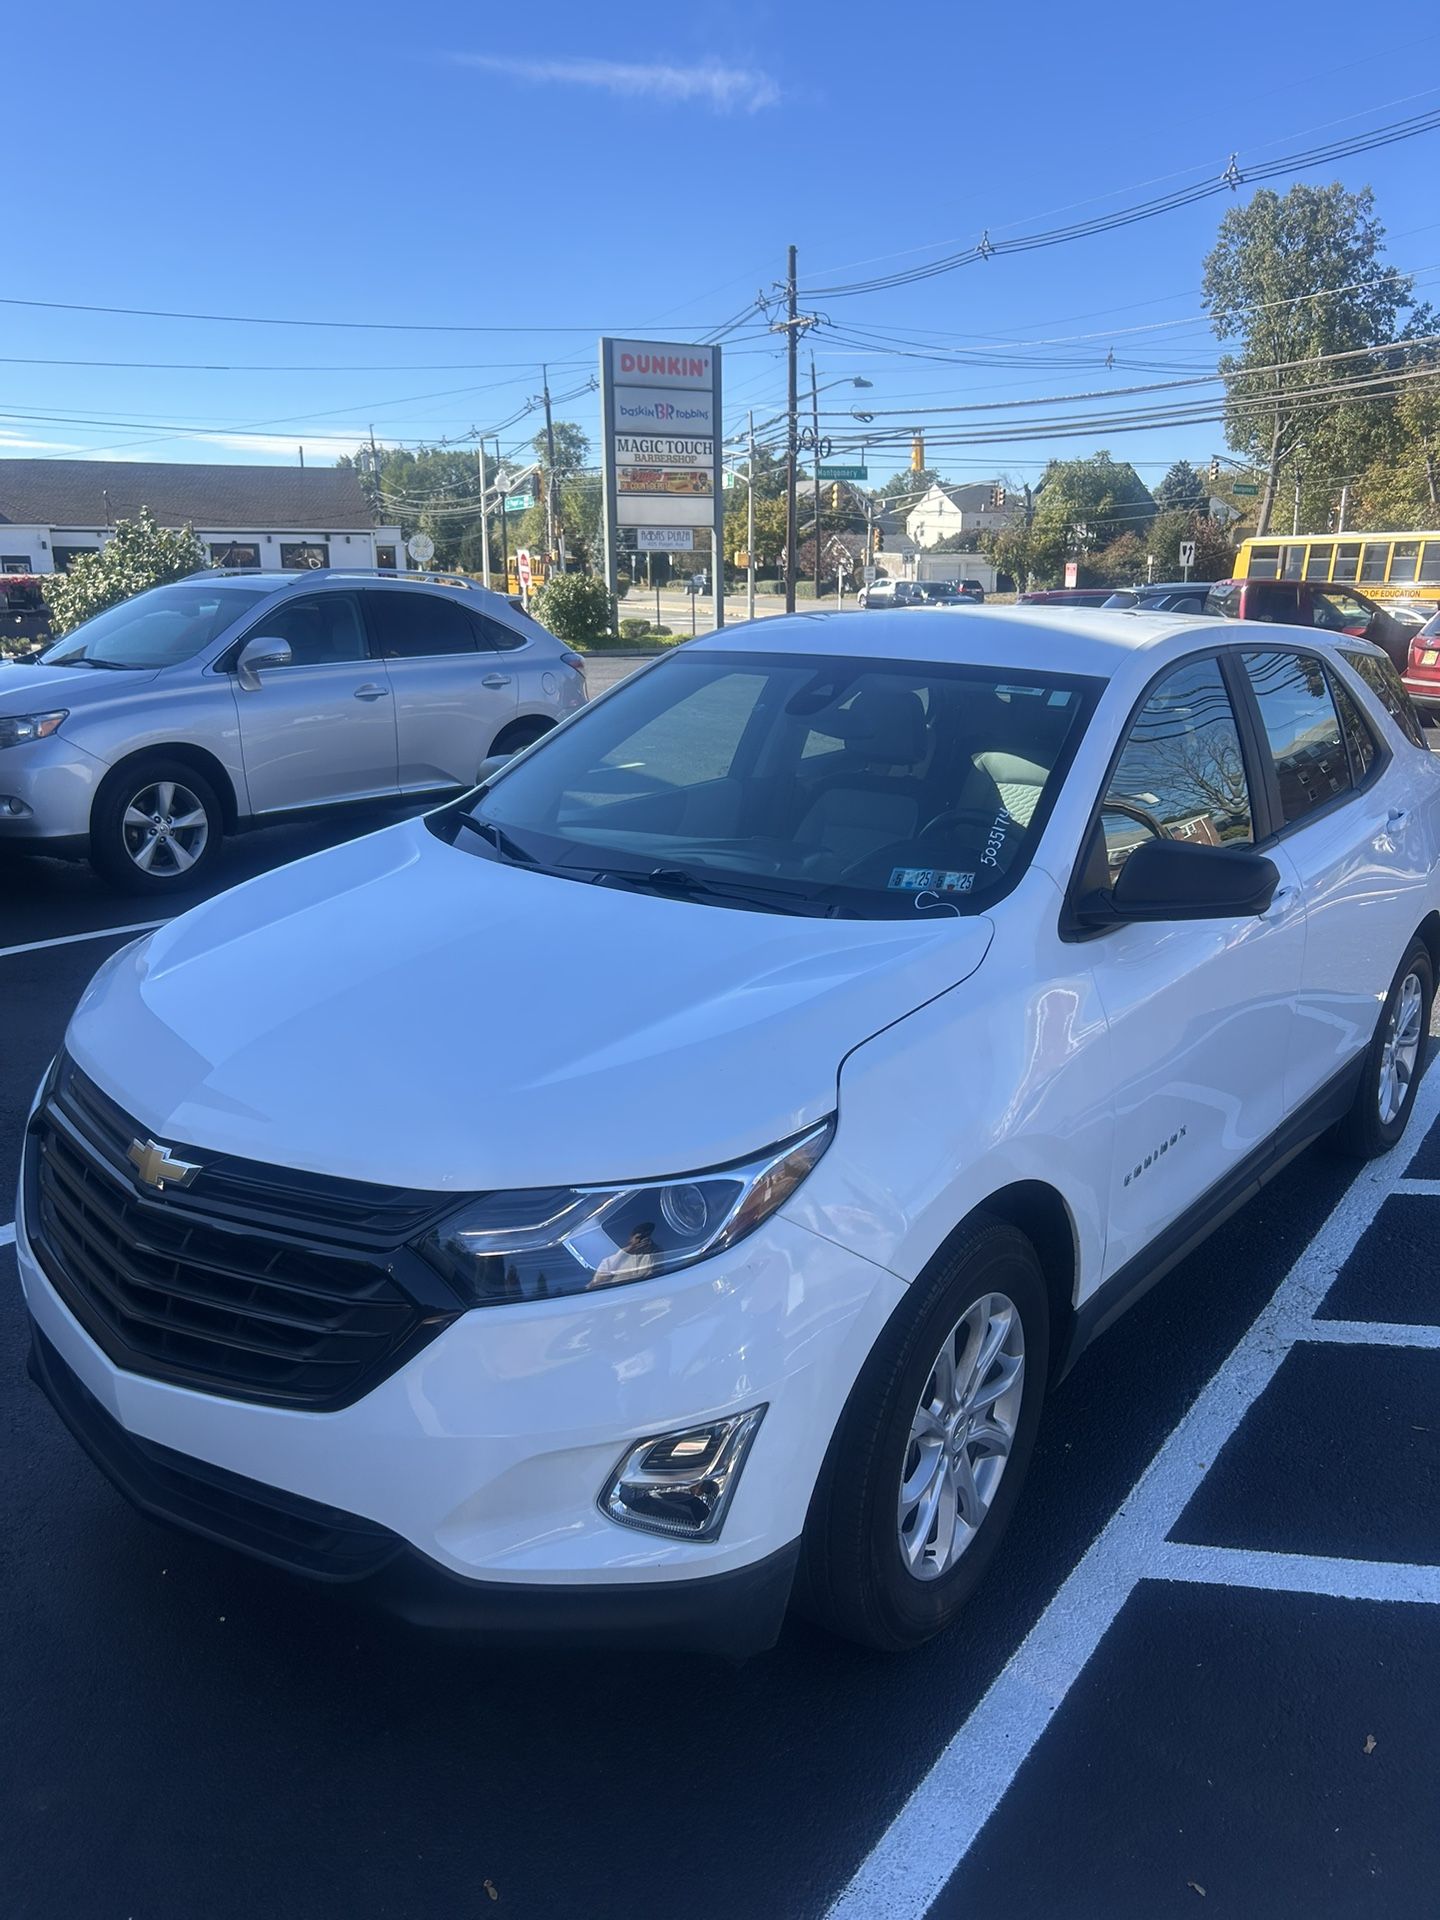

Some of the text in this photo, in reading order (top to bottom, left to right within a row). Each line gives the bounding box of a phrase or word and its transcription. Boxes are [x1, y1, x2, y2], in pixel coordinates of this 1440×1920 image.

[620, 352, 709, 377] DUNKIN'
[619, 403, 709, 421] baskin BR robbins
[617, 438, 713, 455] MAGIC TOUCH
[634, 453, 697, 464] BARBERSHOP
[817, 468, 858, 478] Montgomery
[667, 530, 691, 542] PLAZA
[1370, 590, 1379, 598] OF
[1380, 590, 1421, 598] EDUCATION
[918, 871, 931, 887] 25
[960, 874, 973, 890] 25
